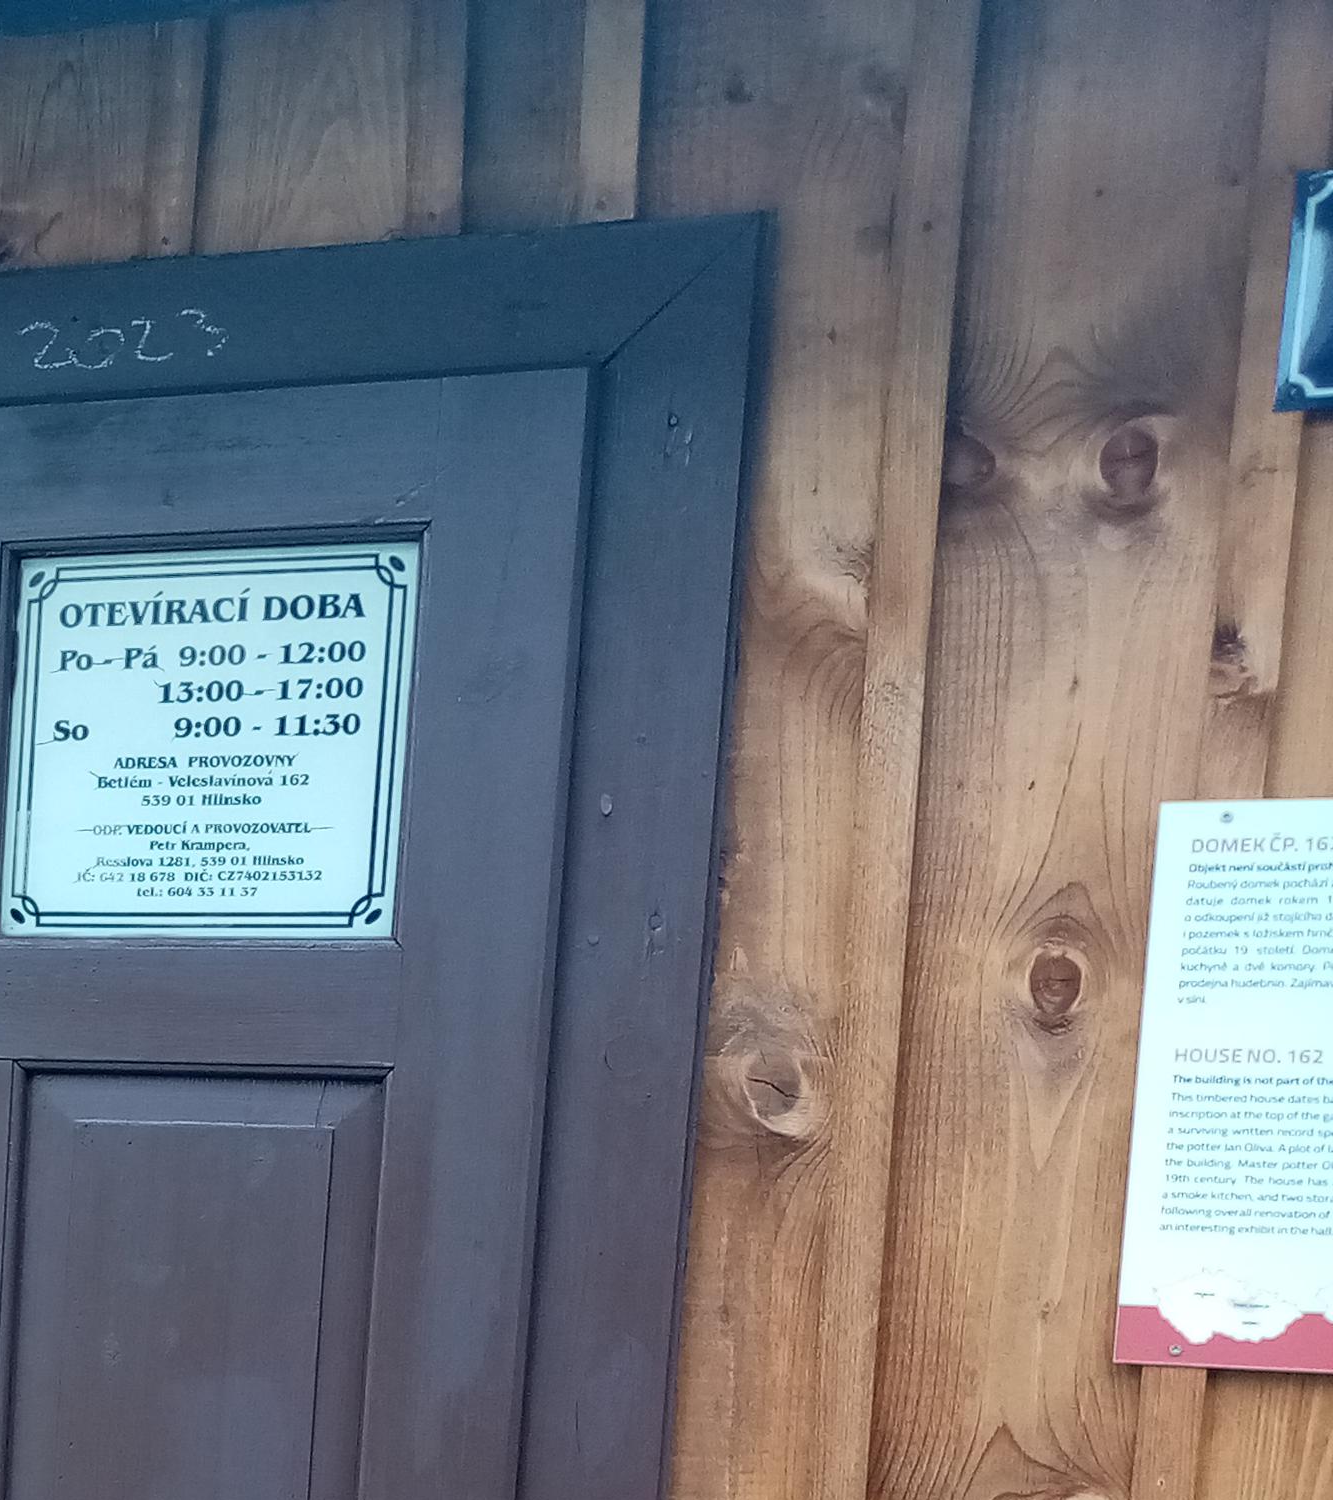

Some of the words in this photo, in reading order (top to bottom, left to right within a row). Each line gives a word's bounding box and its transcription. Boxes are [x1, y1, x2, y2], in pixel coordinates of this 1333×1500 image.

[59, 588, 251, 628] OTEVÍRACÍ
[261, 593, 367, 622] DOBA
[57, 649, 94, 672] Po
[123, 645, 161, 670] Pá
[178, 643, 246, 667] 9:00
[278, 640, 367, 665] 12:00
[157, 679, 244, 704] 13:00
[277, 676, 364, 701] 17:00
[52, 719, 90, 742] So
[173, 715, 242, 738] 9:00
[274, 713, 362, 737] 11:30
[113, 756, 178, 770] ADRESA
[188, 754, 296, 768] PROVOZOVNY
[96, 775, 153, 789] Betlém
[280, 773, 310, 787] 162
[141, 794, 172, 807] 539
[176, 794, 196, 807] 01
[201, 793, 263, 806] Hlinsko
[127, 821, 188, 835] VEDOUCÍ
[190, 823, 201, 834] A
[204, 822, 312, 834] PROVOZOVATEL
[148, 840, 177, 851] Petr
[1191, 837, 1266, 853] DOMEK
[1269, 832, 1299, 853] ČP.
[158, 856, 196, 868] 1281,
[199, 856, 227, 867] 539
[230, 856, 248, 866] 01
[252, 855, 305, 866] Hlinsko
[1188, 863, 1227, 874] Objekt
[1228, 862, 1255, 872] není
[129, 871, 146, 882] 18
[149, 871, 176, 882] 678
[183, 868, 214, 883] DIČ:
[1239, 880, 1280, 889] domek
[136, 887, 164, 898] tel.:
[167, 886, 193, 898] 604
[196, 886, 215, 897] 33
[219, 886, 235, 897] 11
[239, 886, 259, 897] 37
[1185, 896, 1224, 907] datuje
[1230, 896, 1272, 905] domek
[1188, 929, 1240, 940] pozemek
[1174, 1048, 1243, 1063] HOUSE
[1247, 1048, 1282, 1064] NO.
[1288, 1049, 1324, 1064] 162
[1172, 1074, 1193, 1084] The
[1194, 1074, 1240, 1086] building
[1243, 1076, 1251, 1085] is
[1254, 1077, 1274, 1085] not
[1276, 1077, 1300, 1087] part
[1302, 1076, 1314, 1085] of
[1172, 1092, 1194, 1102] This
[1196, 1093, 1247, 1103] timbered
[1250, 1094, 1286, 1104] house
[1288, 1095, 1320, 1104] dates
[1168, 1110, 1228, 1120] inscription
[1230, 1111, 1241, 1119] at
[1243, 1111, 1263, 1120] the
[1265, 1111, 1285, 1122] top
[1286, 1111, 1299, 1120] of
[1301, 1111, 1321, 1120] the
[1167, 1127, 1174, 1135] a
[1177, 1126, 1228, 1138] surviving
[1231, 1127, 1274, 1136] written
[1277, 1128, 1315, 1137] record
[1166, 1142, 1184, 1151] the
[1186, 1142, 1221, 1153] potter
[1224, 1143, 1242, 1153] Jan
[1277, 1143, 1287, 1153] A
[1288, 1144, 1311, 1155] plot
[1313, 1144, 1326, 1154] of
[1165, 1158, 1183, 1167] the
[1237, 1159, 1279, 1169] Master
[1281, 1160, 1319, 1171] potter
[1165, 1173, 1191, 1183] 19th
[1244, 1175, 1265, 1185] The
[1268, 1175, 1304, 1186] house
[1307, 1176, 1329, 1187] has
[1161, 1191, 1169, 1200] a
[1170, 1191, 1208, 1200] smoke
[1256, 1193, 1279, 1203] and
[1281, 1193, 1304, 1203] two
[1160, 1204, 1213, 1218] following
[1214, 1208, 1252, 1218] overall
[1254, 1210, 1317, 1220] renovation
[1318, 1210, 1331, 1220] of
[1159, 1223, 1173, 1231] an
[1174, 1223, 1236, 1236] interesting
[1237, 1225, 1275, 1235] exhibit
[1277, 1227, 1289, 1235] in
[1290, 1227, 1309, 1236] the
